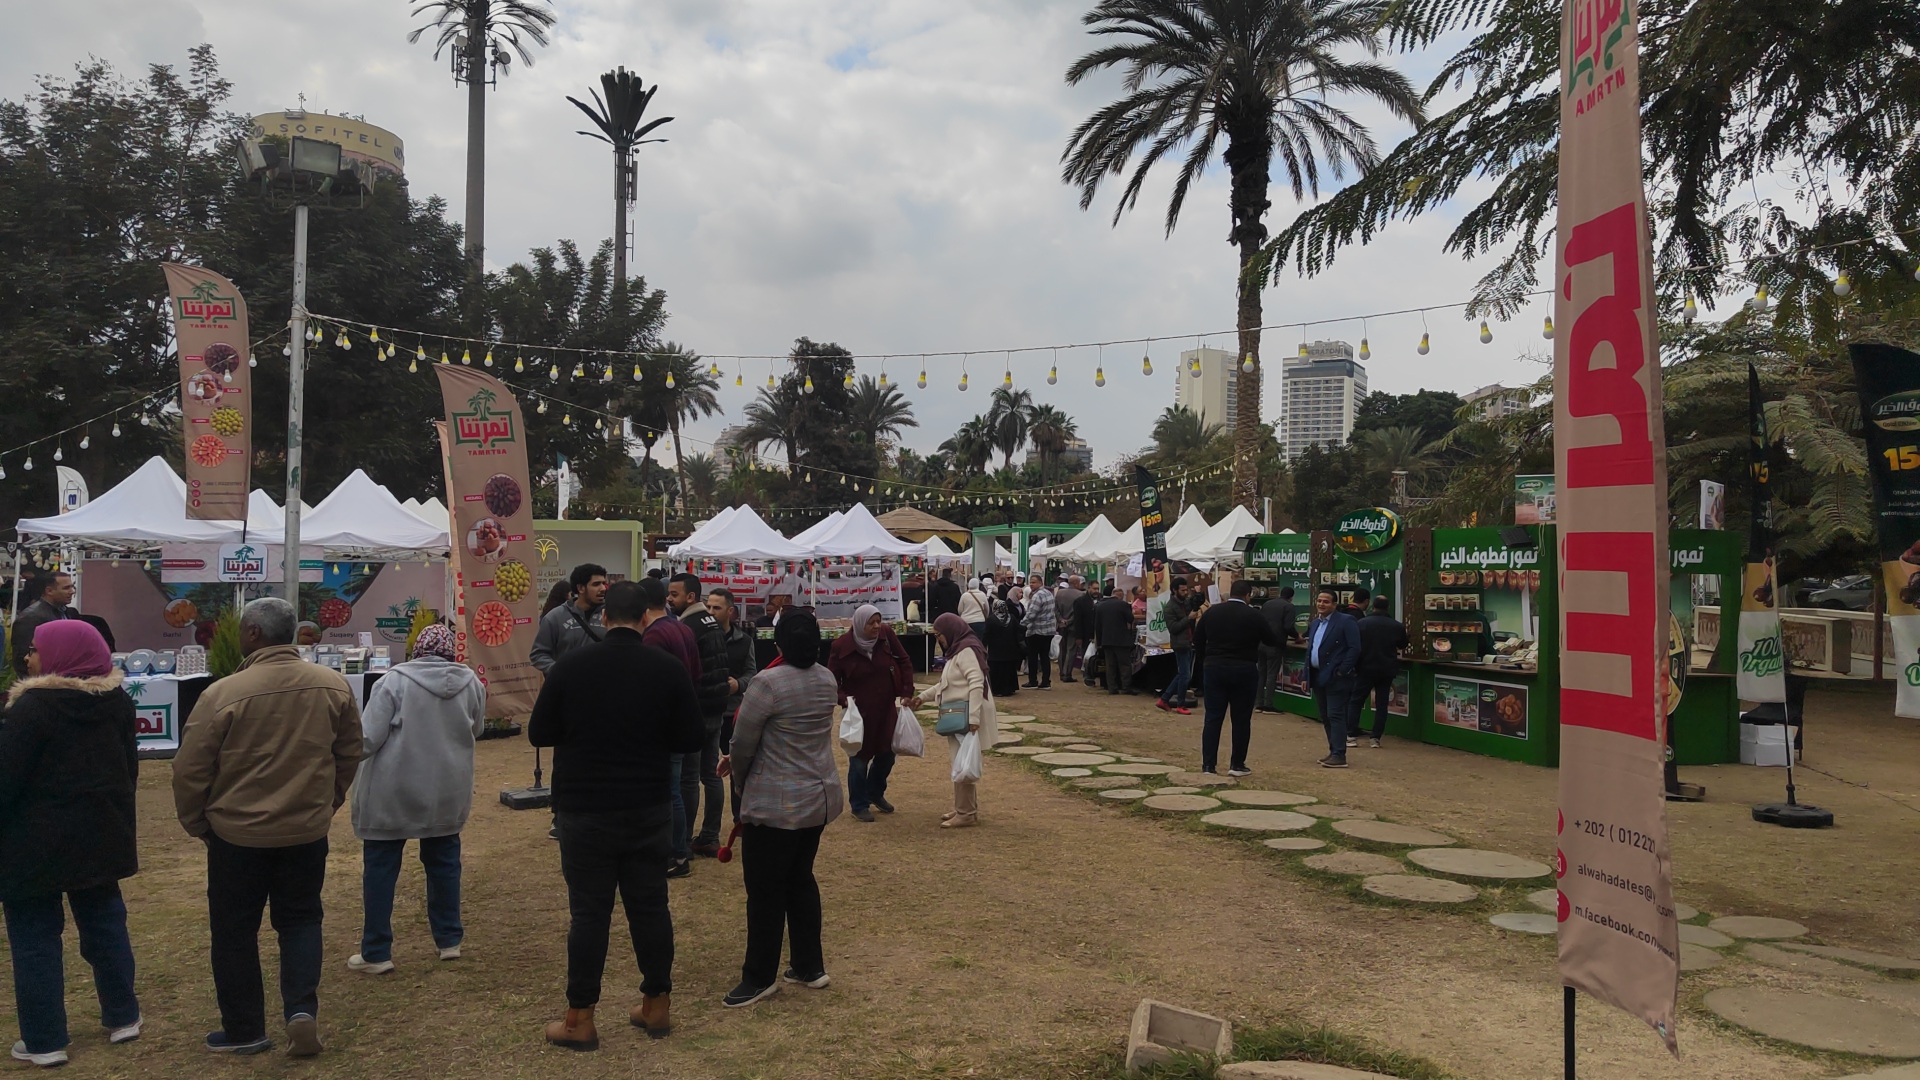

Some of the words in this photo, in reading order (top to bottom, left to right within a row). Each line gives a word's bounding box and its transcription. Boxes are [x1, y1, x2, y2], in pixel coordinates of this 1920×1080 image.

[279, 123, 382, 148] SOFITEL
[183, 300, 231, 320] تمرتنا
[459, 417, 509, 445] تمرتنا
[1339, 518, 1361, 532] الخير
[1360, 516, 1388, 533] قطوف
[1252, 548, 1268, 566] الخير
[1268, 548, 1293, 566] قطوف
[1440, 546, 1466, 569] الخير
[1466, 545, 1508, 569] قطوف
[1509, 545, 1539, 569] تمور
[1672, 545, 1704, 568] تمور
[226, 560, 260, 575] تمرتنا
[1584, 820, 1605, 838] 202
